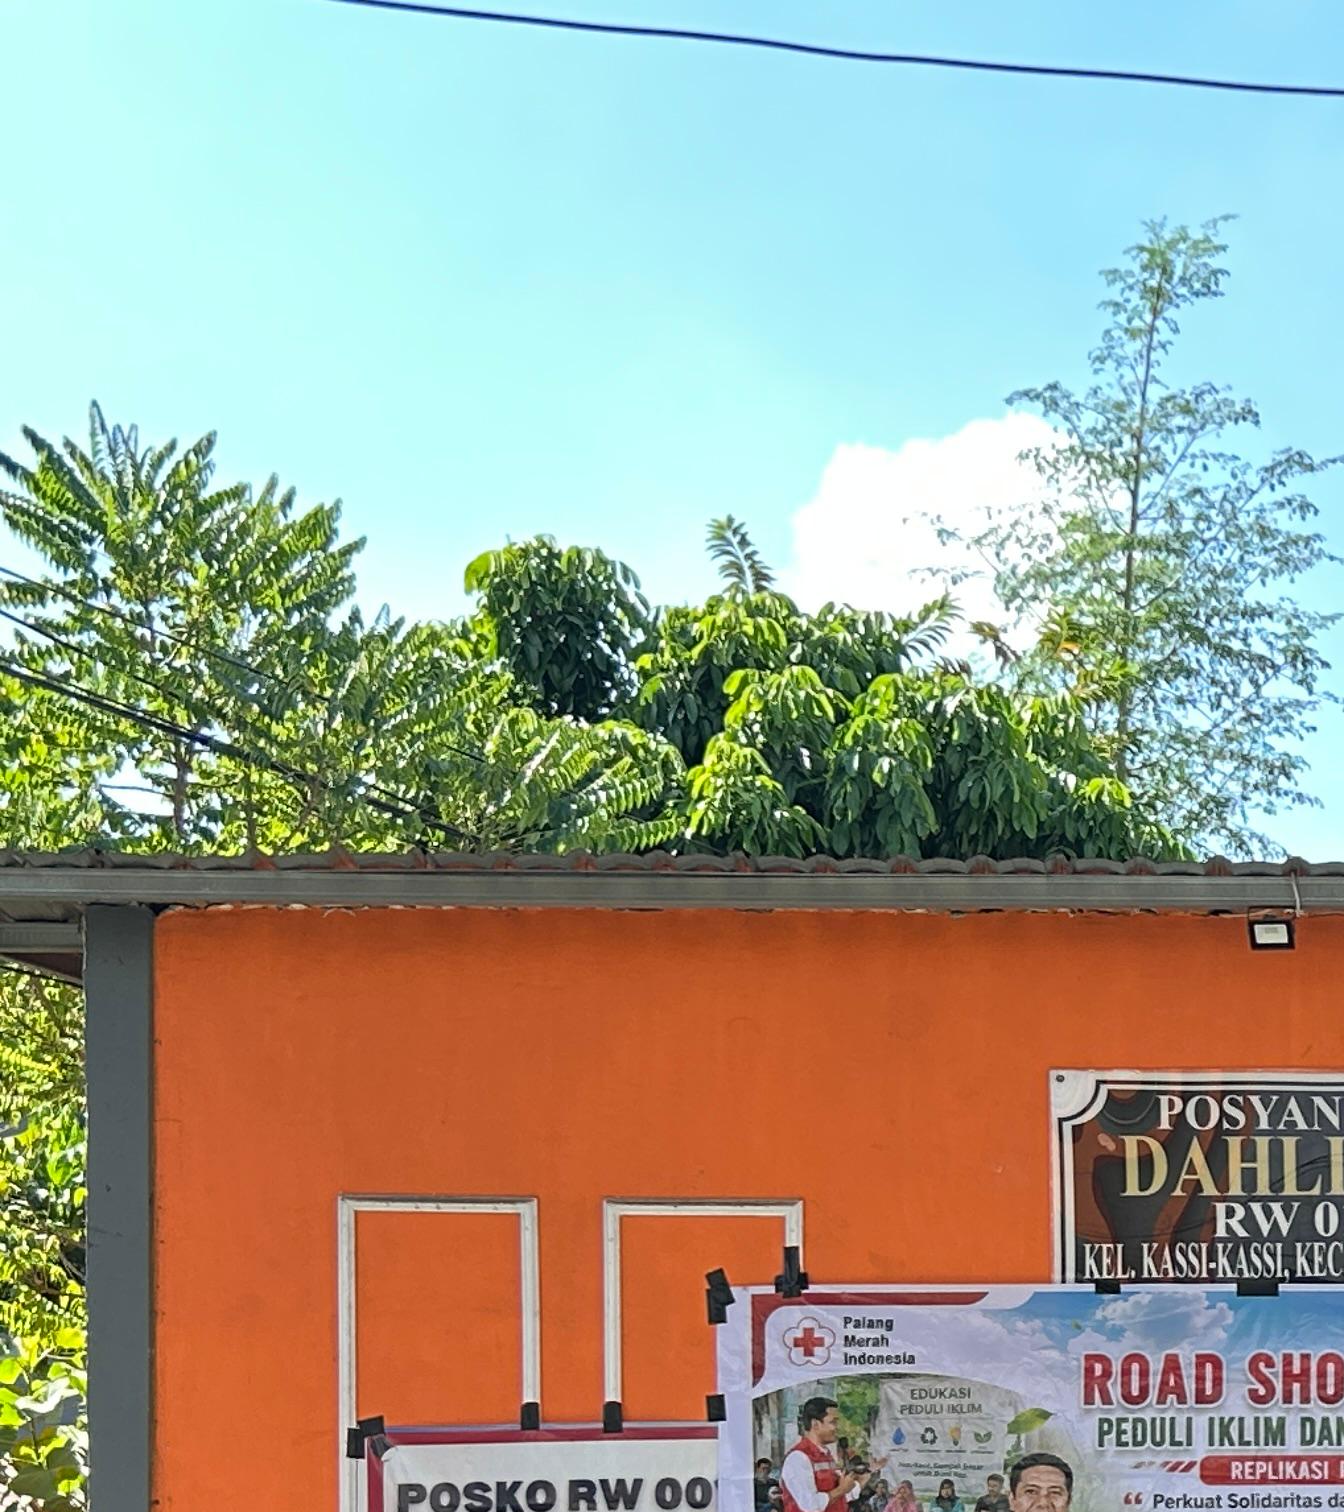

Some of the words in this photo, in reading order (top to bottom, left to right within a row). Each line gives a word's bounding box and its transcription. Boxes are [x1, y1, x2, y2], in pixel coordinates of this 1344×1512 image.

[1214, 1202, 1300, 1238] RW
[1083, 1242, 1136, 1280] KEL.
[1142, 1242, 1289, 1282] KASSI-KASSI,
[843, 1317, 894, 1332] Palang
[843, 1335, 889, 1348] Merah
[843, 1352, 916, 1365] Indonesia
[1082, 1351, 1224, 1407] ROAD
[910, 1388, 971, 1400] EDUKASI
[900, 1404, 943, 1415] PEDULI
[948, 1404, 982, 1413] IKLIM
[1097, 1416, 1194, 1448] PEDULI
[1208, 1416, 1287, 1448] IKLIM
[1230, 1461, 1330, 1480] REPLIKASI
[568, 1478, 643, 1511] RW
[655, 1477, 718, 1510] 00
[1153, 1493, 1223, 1509] Perkuat
[1227, 1492, 1322, 1508] Solidaritas
